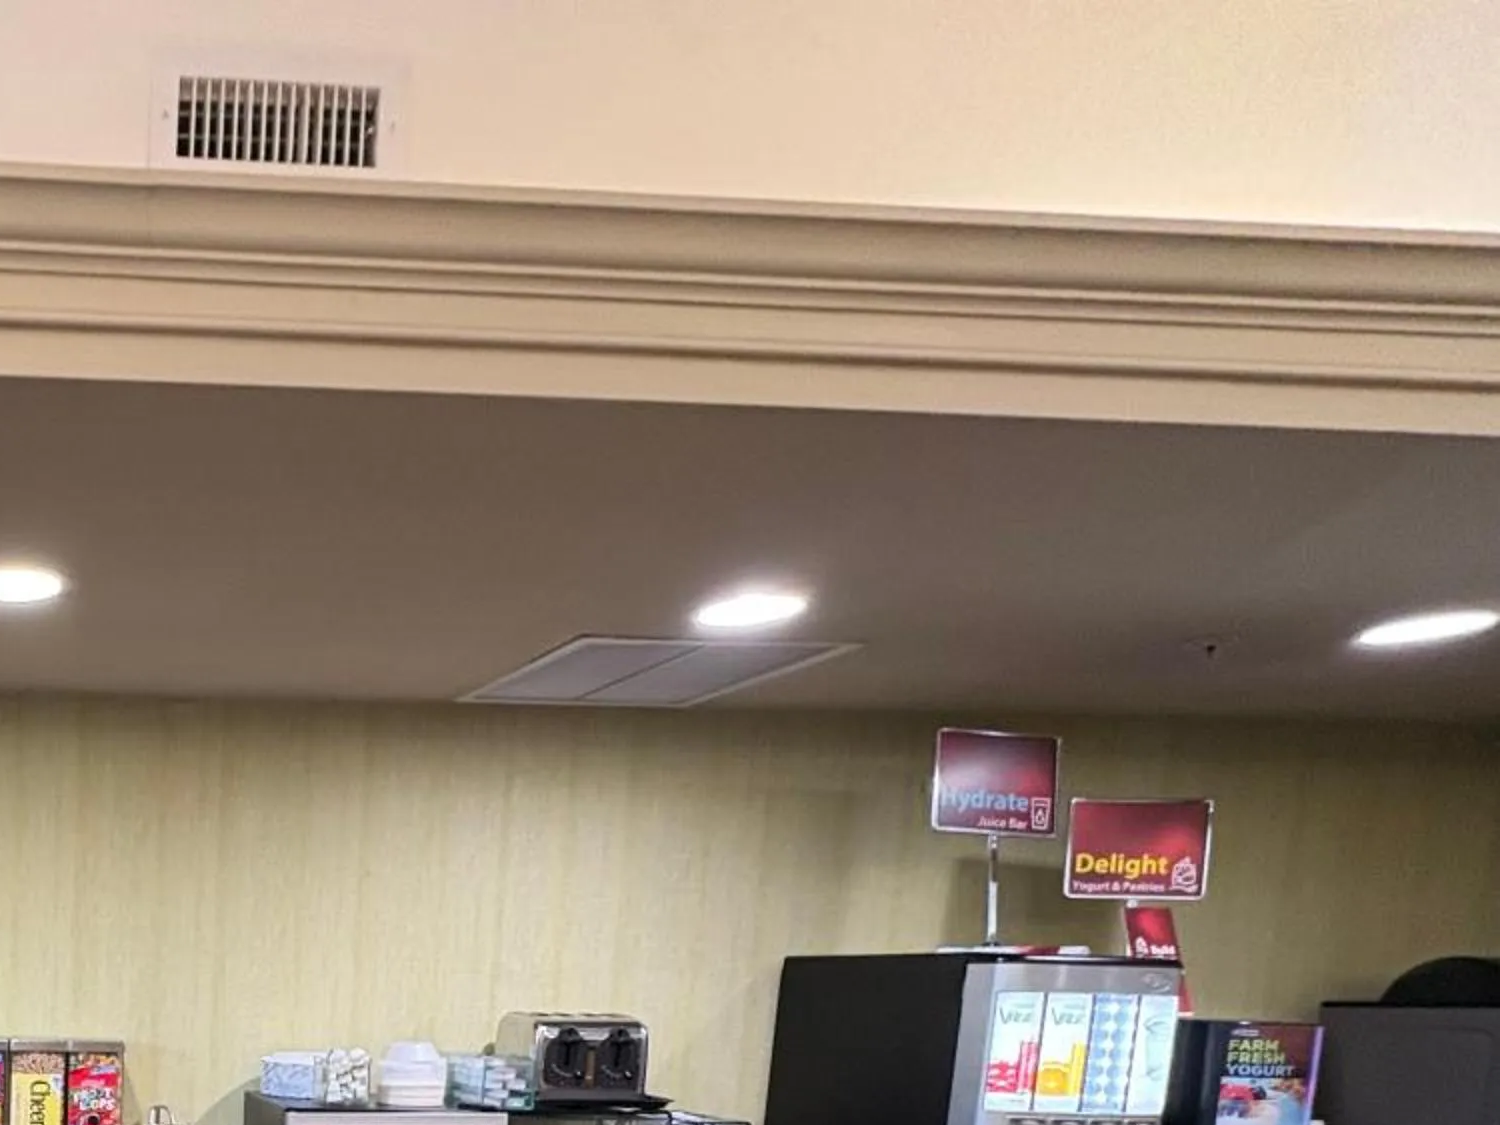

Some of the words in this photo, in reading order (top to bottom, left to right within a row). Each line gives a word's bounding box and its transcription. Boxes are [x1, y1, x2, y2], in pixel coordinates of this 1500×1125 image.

[941, 787, 1028, 813] Hydrate
[977, 816, 1007, 828] Juice
[1009, 817, 1029, 830] Bar
[1075, 852, 1168, 880] Delight
[1072, 880, 1110, 892] Yogurt
[1111, 881, 1121, 892] &
[1228, 1039, 1280, 1051] FARM
[1227, 1051, 1286, 1064] FRESH
[1226, 1064, 1296, 1077] YOGURT
